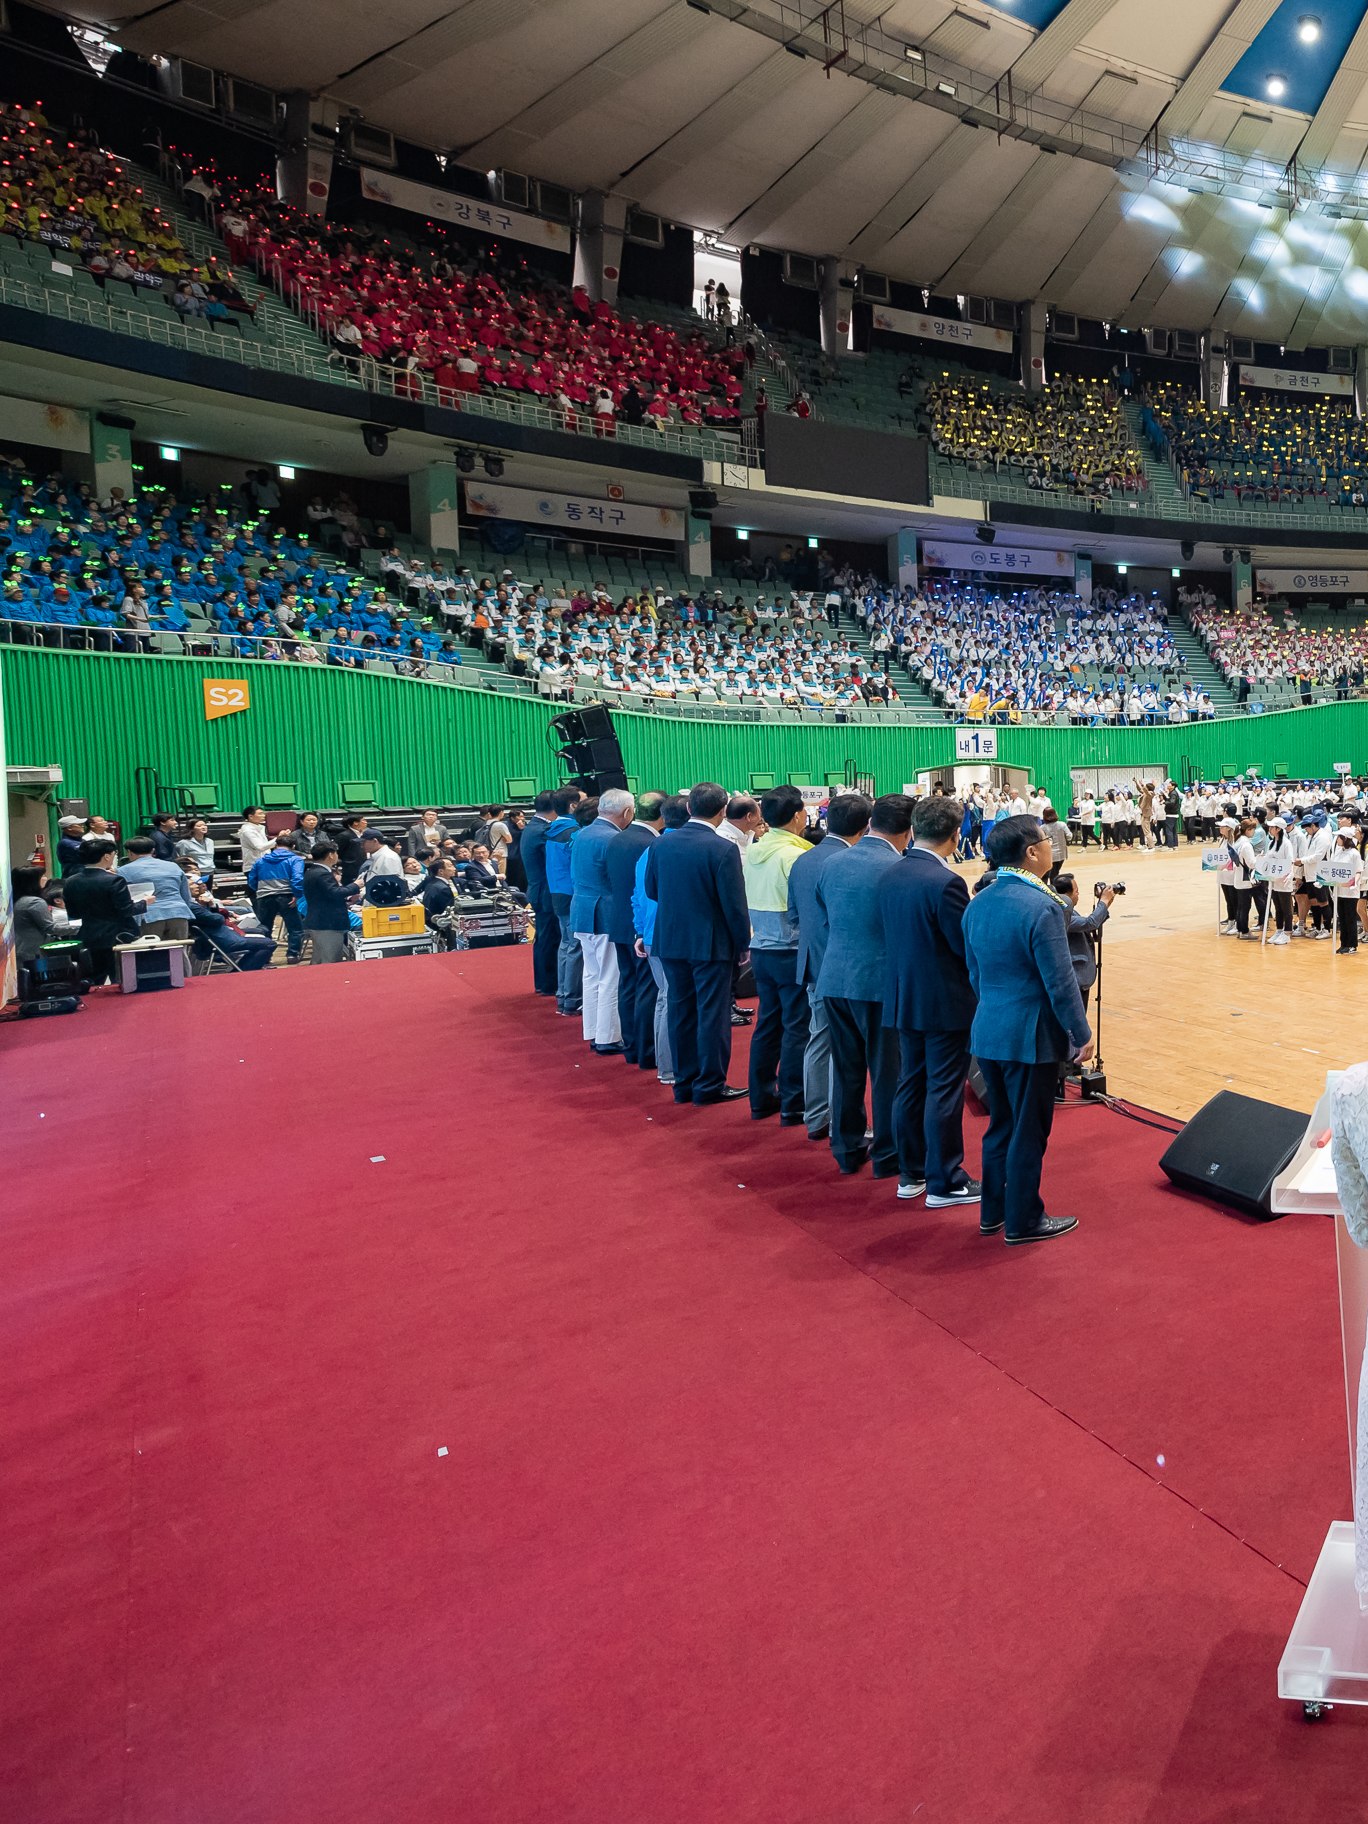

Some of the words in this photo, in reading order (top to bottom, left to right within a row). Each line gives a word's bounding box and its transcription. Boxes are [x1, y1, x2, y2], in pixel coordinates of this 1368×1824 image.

[454, 201, 514, 231] 강북구
[934, 321, 973, 340] 양천구
[1288, 374, 1321, 388] 금천구
[105, 443, 122, 463] 3
[437, 498, 452, 511] 4
[564, 502, 626, 526] 동작구
[694, 531, 706, 544] 4
[903, 554, 912, 565] 5
[988, 552, 1032, 568] 도봉구
[1079, 570, 1088, 580] 5
[1307, 574, 1351, 588] 영등포구
[1240, 579, 1248, 589] 6
[209, 687, 246, 707] S2
[801, 790, 824, 800] 등포구
[1271, 864, 1284, 874] 중구
[1331, 867, 1352, 879] 동대문구
